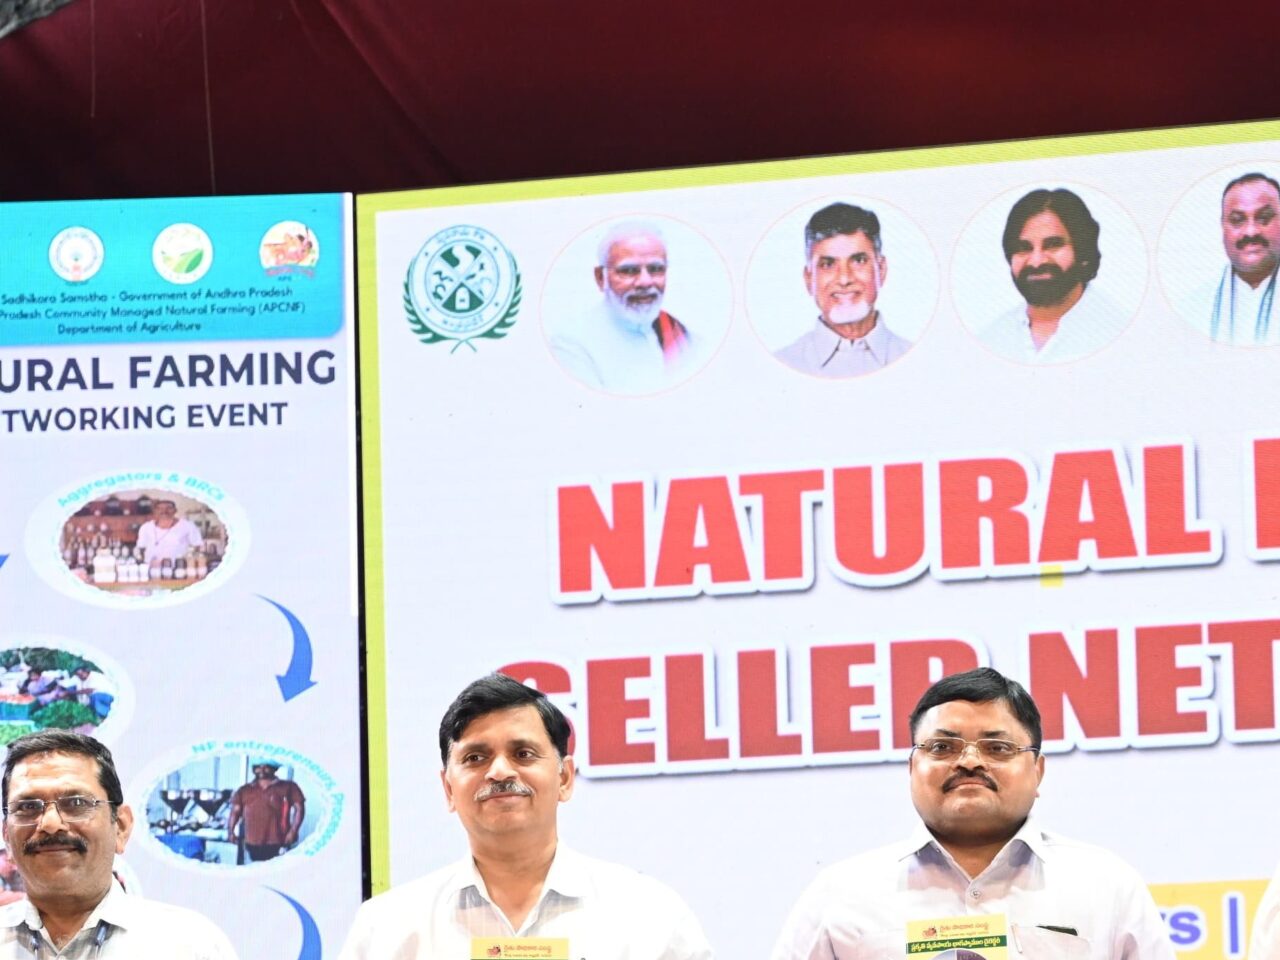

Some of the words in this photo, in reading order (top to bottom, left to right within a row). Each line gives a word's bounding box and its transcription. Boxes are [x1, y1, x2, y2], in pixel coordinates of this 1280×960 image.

[119, 290, 187, 302] Government
[190, 289, 202, 300] of
[205, 287, 247, 299] Andhra
[249, 286, 293, 298] Pradesh
[45, 306, 107, 319] Community
[111, 305, 162, 318] Managed
[166, 303, 207, 316] Natural
[211, 302, 256, 316] Farming
[258, 302, 306, 314] (APCNF)
[58, 323, 123, 336] Department
[126, 321, 138, 332] of
[141, 320, 202, 334] Agriculture
[129, 350, 336, 389] FARMING
[2, 404, 177, 432] TWORKING
[187, 402, 289, 428] EVENT
[58, 473, 162, 508] Aggregators
[167, 472, 181, 483] &
[556, 444, 1213, 594] NATURAL
[191, 741, 217, 753] NF
